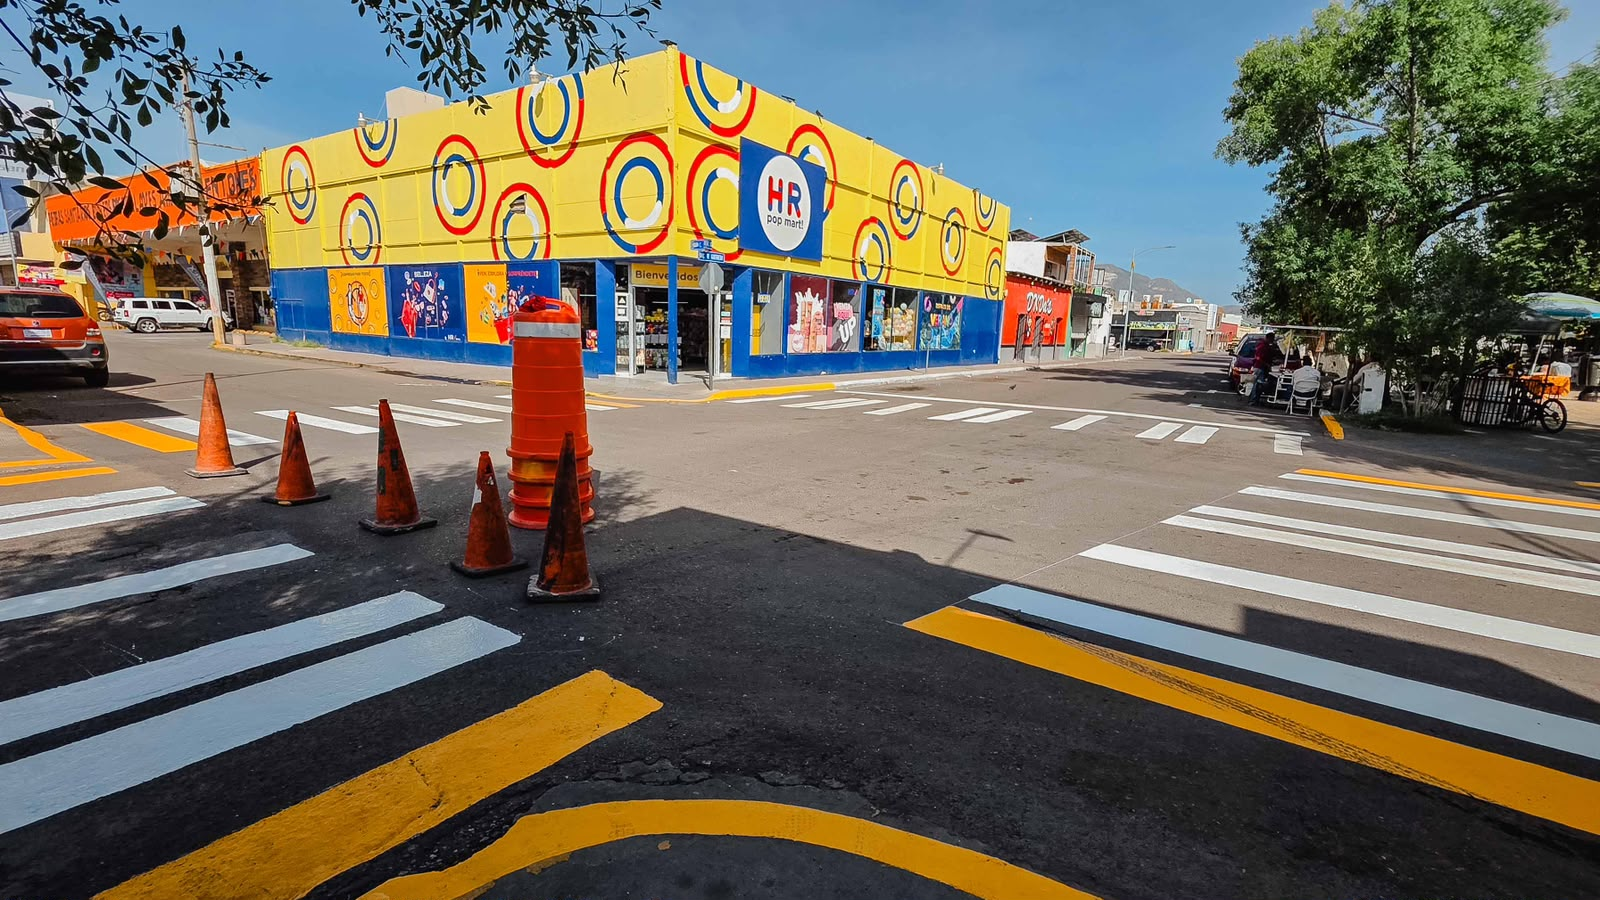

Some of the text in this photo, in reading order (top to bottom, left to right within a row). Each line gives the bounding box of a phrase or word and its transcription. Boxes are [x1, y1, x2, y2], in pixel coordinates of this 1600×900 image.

[768, 175, 801, 218] HR
[767, 215, 804, 230] pop mart!
[635, 270, 699, 282] Bienveidos
[838, 316, 857, 343] UP
